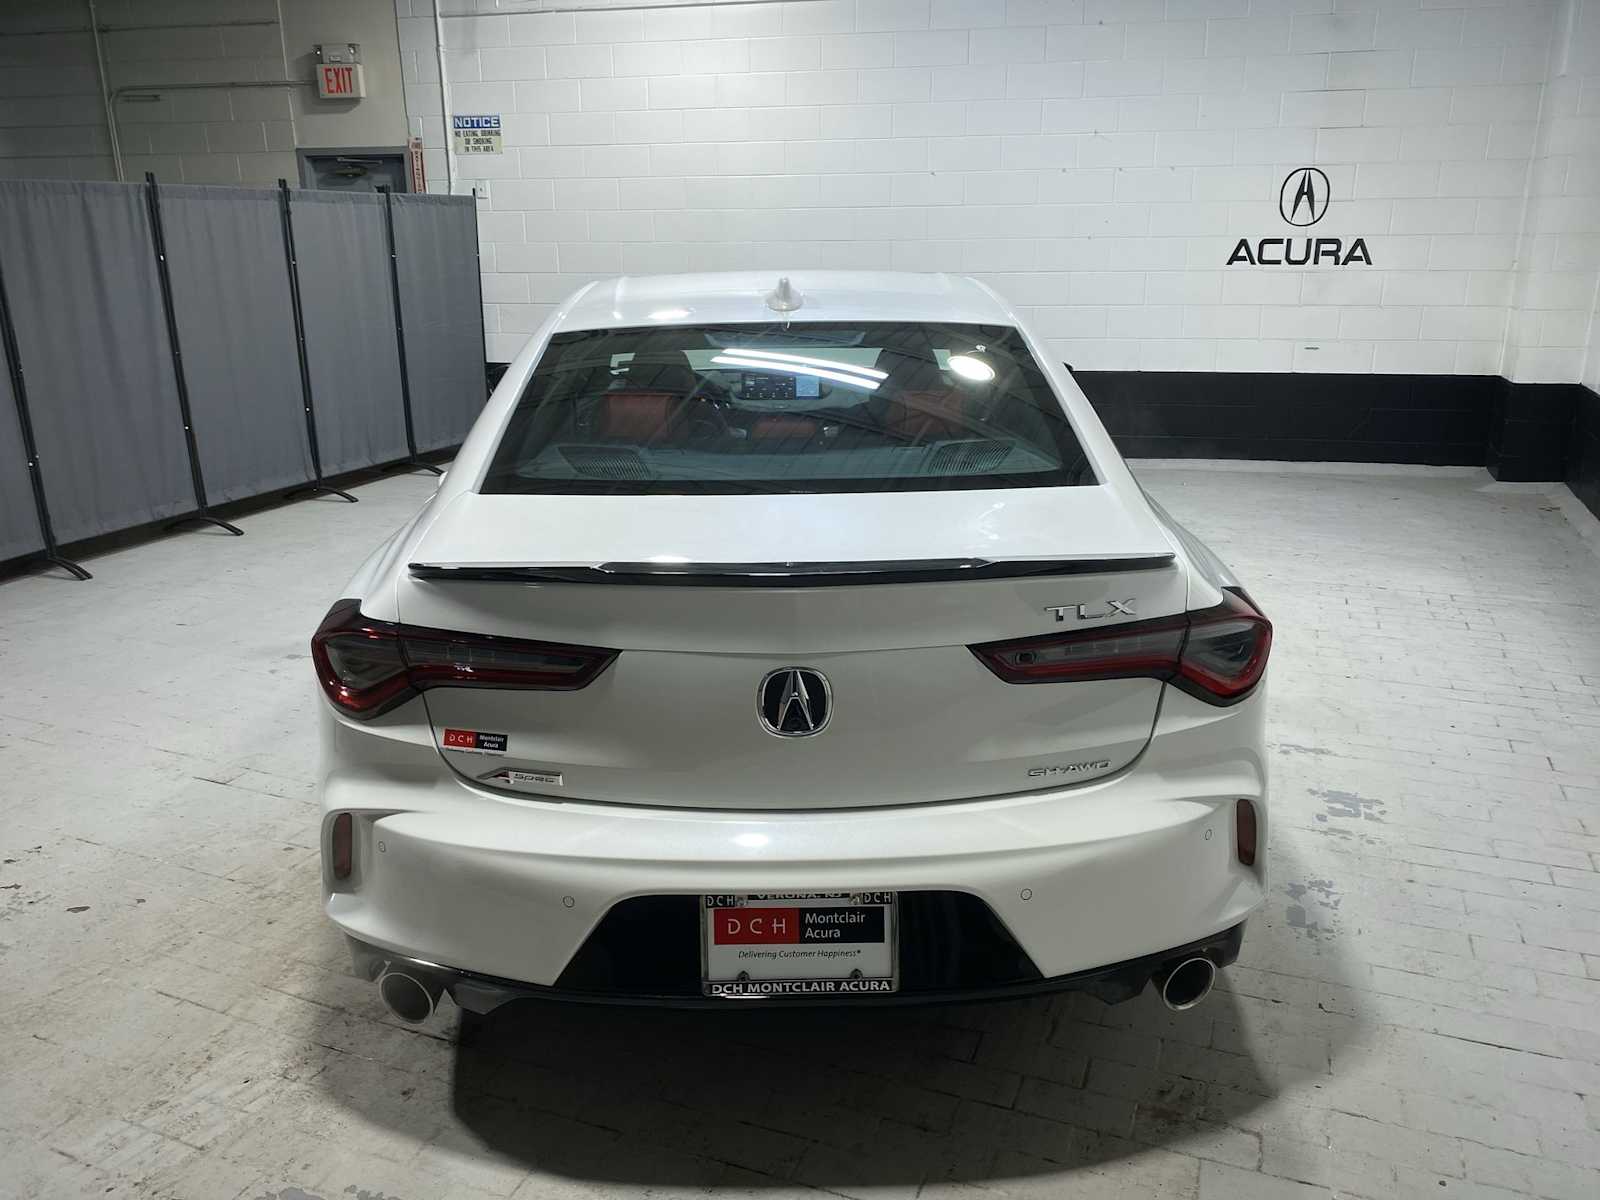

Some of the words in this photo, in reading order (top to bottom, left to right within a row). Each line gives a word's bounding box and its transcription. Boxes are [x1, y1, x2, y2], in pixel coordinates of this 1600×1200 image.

[324, 67, 353, 94] EXIT
[455, 117, 500, 128] NOTICE
[1226, 238, 1373, 266] ACURA
[1044, 598, 1137, 621] TLX
[483, 741, 499, 749] Acura
[805, 912, 866, 924] Montclair
[805, 927, 841, 938] Acura
[738, 951, 777, 960] Delivering
[779, 950, 816, 958] Customer
[712, 984, 743, 994] DCH
[747, 982, 836, 993] MONTCLAIR
[839, 981, 890, 991] ACURA
